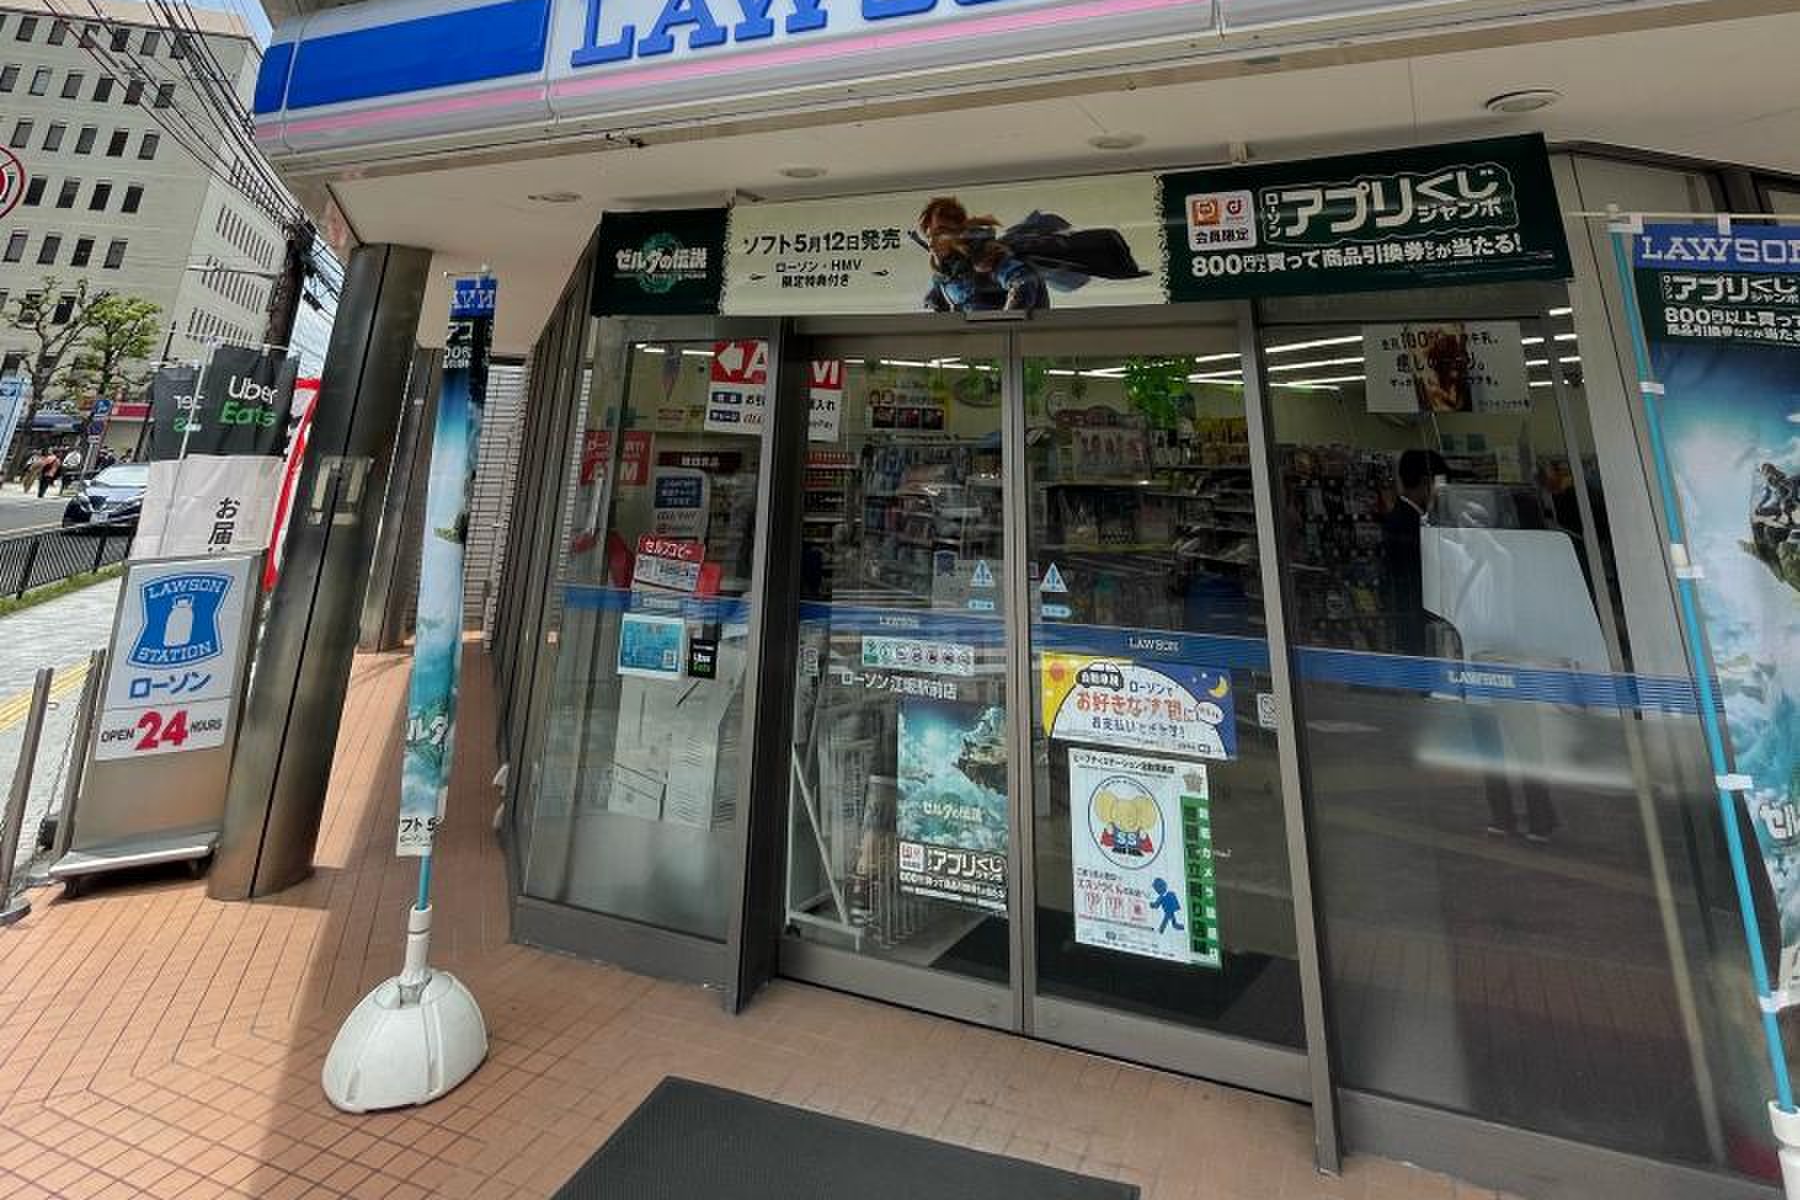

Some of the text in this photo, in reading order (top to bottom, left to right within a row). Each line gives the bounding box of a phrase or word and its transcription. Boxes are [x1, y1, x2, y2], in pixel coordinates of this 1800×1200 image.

[743, 228, 901, 255] ソフト5月12日発売
[1194, 228, 1250, 245] 会員限定
[228, 375, 278, 404] Uber
[219, 400, 277, 428] Eats
[207, 497, 240, 553] お届
[148, 578, 224, 600] LAWSON
[138, 641, 212, 662] STATION
[130, 671, 211, 698] ローソン
[101, 710, 223, 751] OPEN 24 HOURS
[1116, 832, 1138, 846] SS
